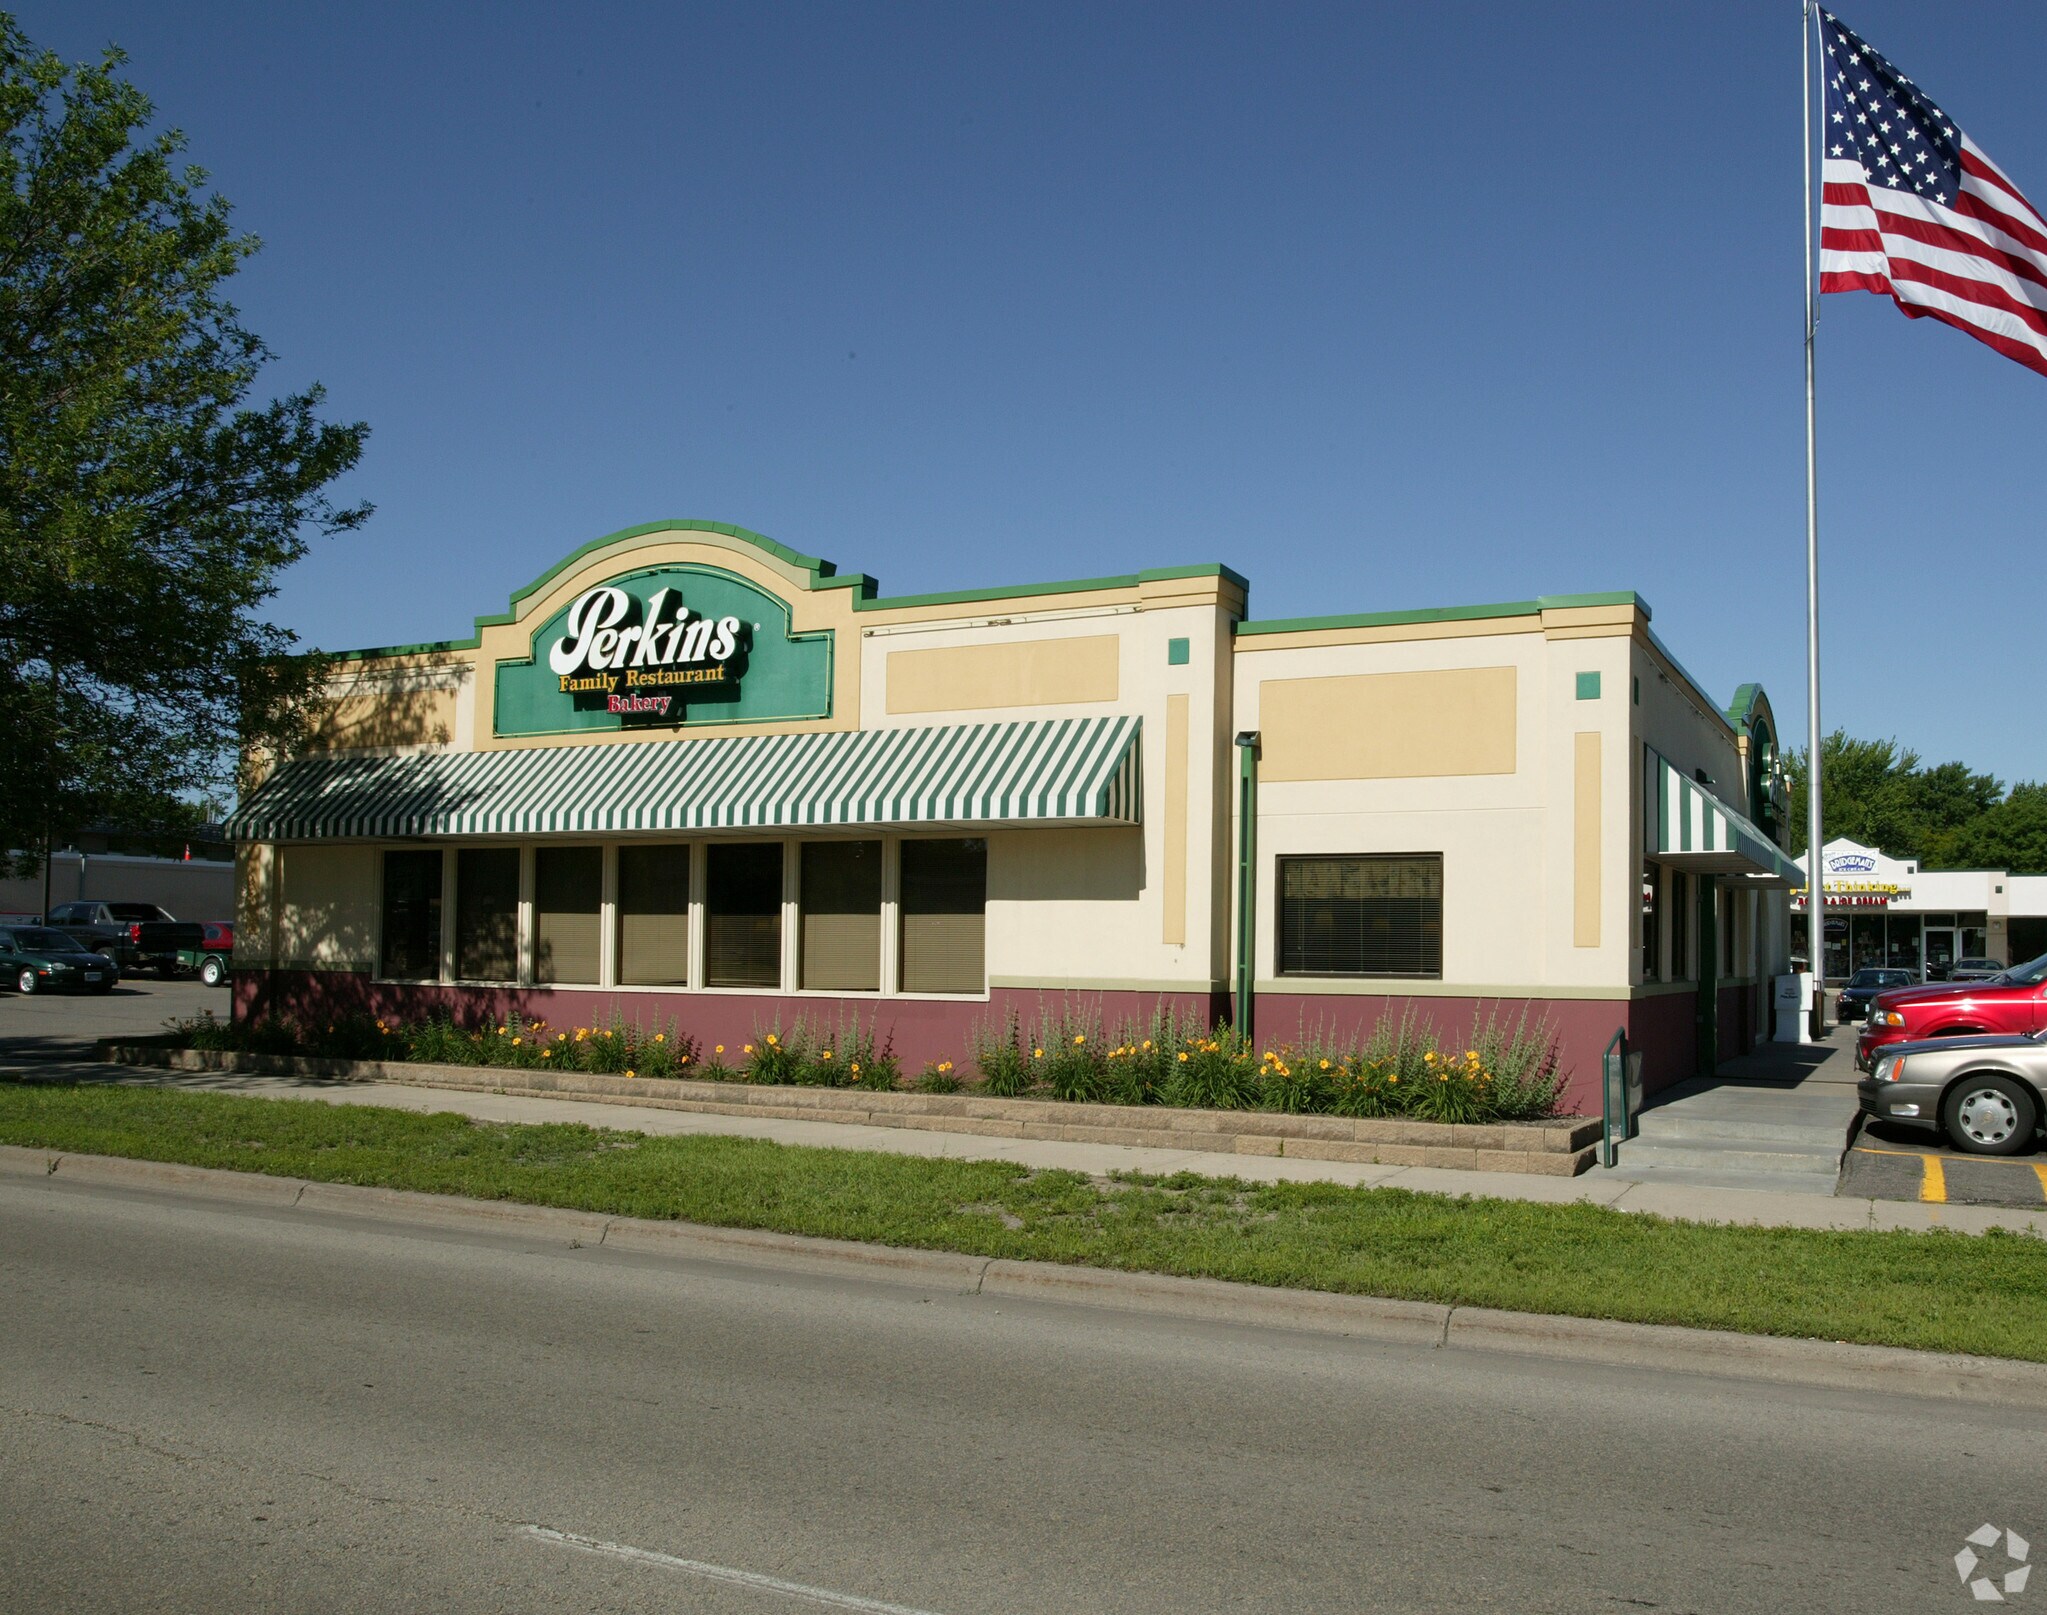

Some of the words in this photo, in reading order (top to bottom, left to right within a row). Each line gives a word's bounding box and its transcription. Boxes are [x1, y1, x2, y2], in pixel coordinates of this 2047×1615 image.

[549, 587, 740, 675] Perkins
[559, 674, 620, 692] Family
[626, 664, 725, 687] Restaurant
[607, 694, 672, 716] Bakery
